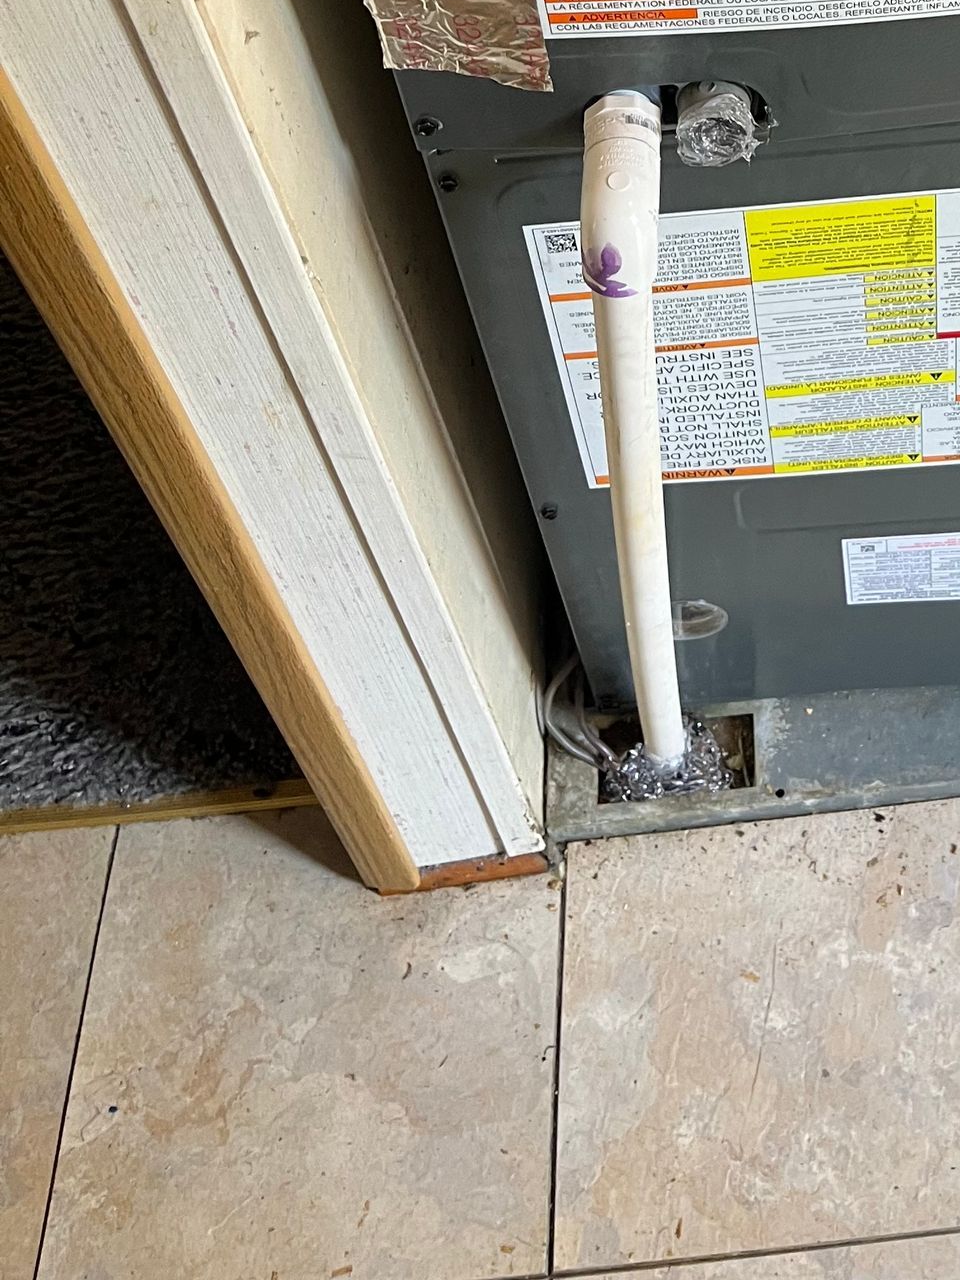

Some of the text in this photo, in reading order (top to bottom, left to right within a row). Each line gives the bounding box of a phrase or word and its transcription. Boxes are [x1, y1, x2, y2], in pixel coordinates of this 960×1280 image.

[581, 9, 666, 23] ADVERTENCIA
[873, 271, 922, 282] ATENCIÓN
[869, 282, 923, 293] ATTENTION
[879, 294, 922, 304] CAUTION
[877, 308, 926, 318] ATENCIÓN
[871, 321, 924, 331] ATTENTION
[882, 334, 923, 343] CAUTION
[721, 348, 753, 359] SEE
[678, 359, 755, 372] SPECIFIC
[675, 369, 756, 383] USE WITH
[685, 379, 757, 392] DEVICES
[715, 389, 758, 400] THAN
[659, 399, 759, 413] DUCTWORK.
[673, 409, 761, 422] INSTALLED
[673, 419, 762, 432] SHALL NOT
[855, 421, 905, 429] ATTENTION
[693, 428, 763, 440] IGNITION
[675, 437, 764, 450] WHICH MAY
[687, 446, 765, 458] AUXILIARY
[705, 458, 726, 466] OF
[731, 455, 766, 464] RISK
[813, 457, 862, 465] OPERATING
[661, 468, 721, 479] WARNIN
